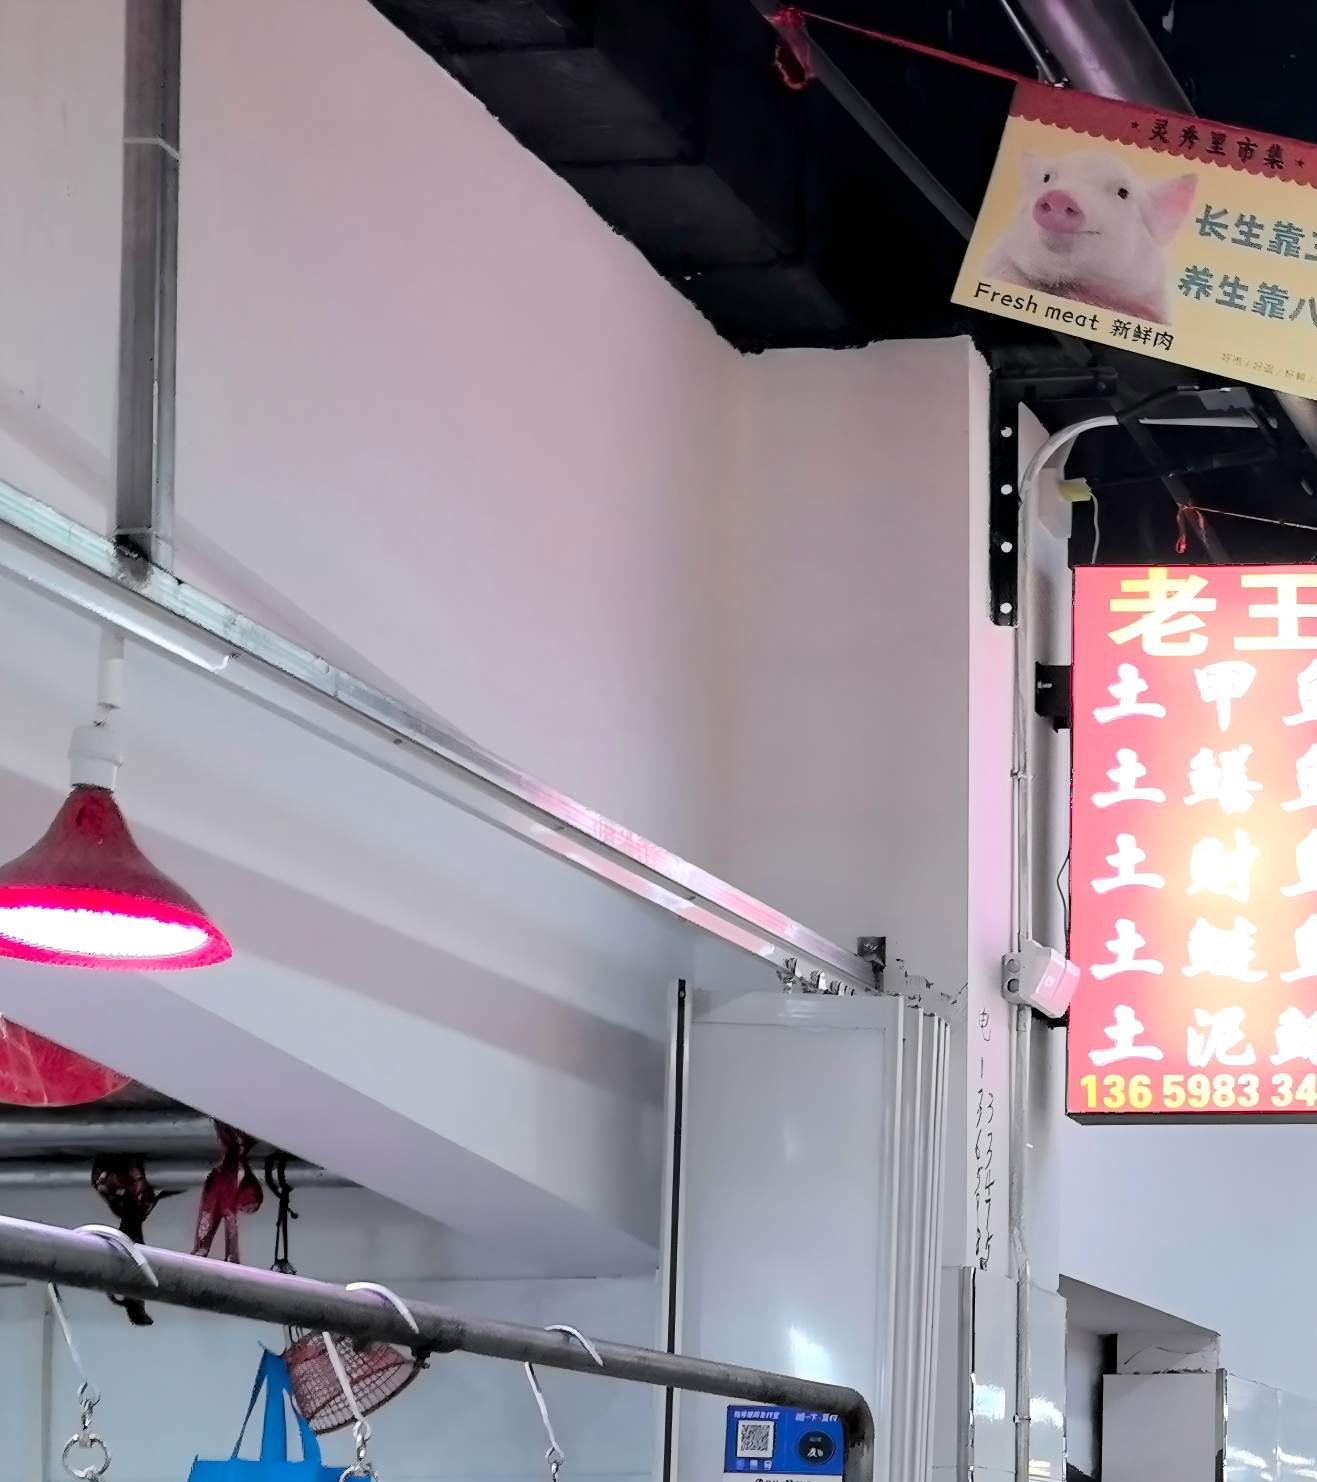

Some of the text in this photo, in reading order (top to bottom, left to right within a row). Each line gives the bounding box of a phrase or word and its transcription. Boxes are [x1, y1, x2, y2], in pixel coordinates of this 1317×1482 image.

[1150, 118, 1285, 168] 灵秀里市集
[974, 281, 1174, 350] Fresh meat 新鲜肉
[1081, 1074, 1152, 1108] 136
[1163, 1074, 1260, 1108] 5983
